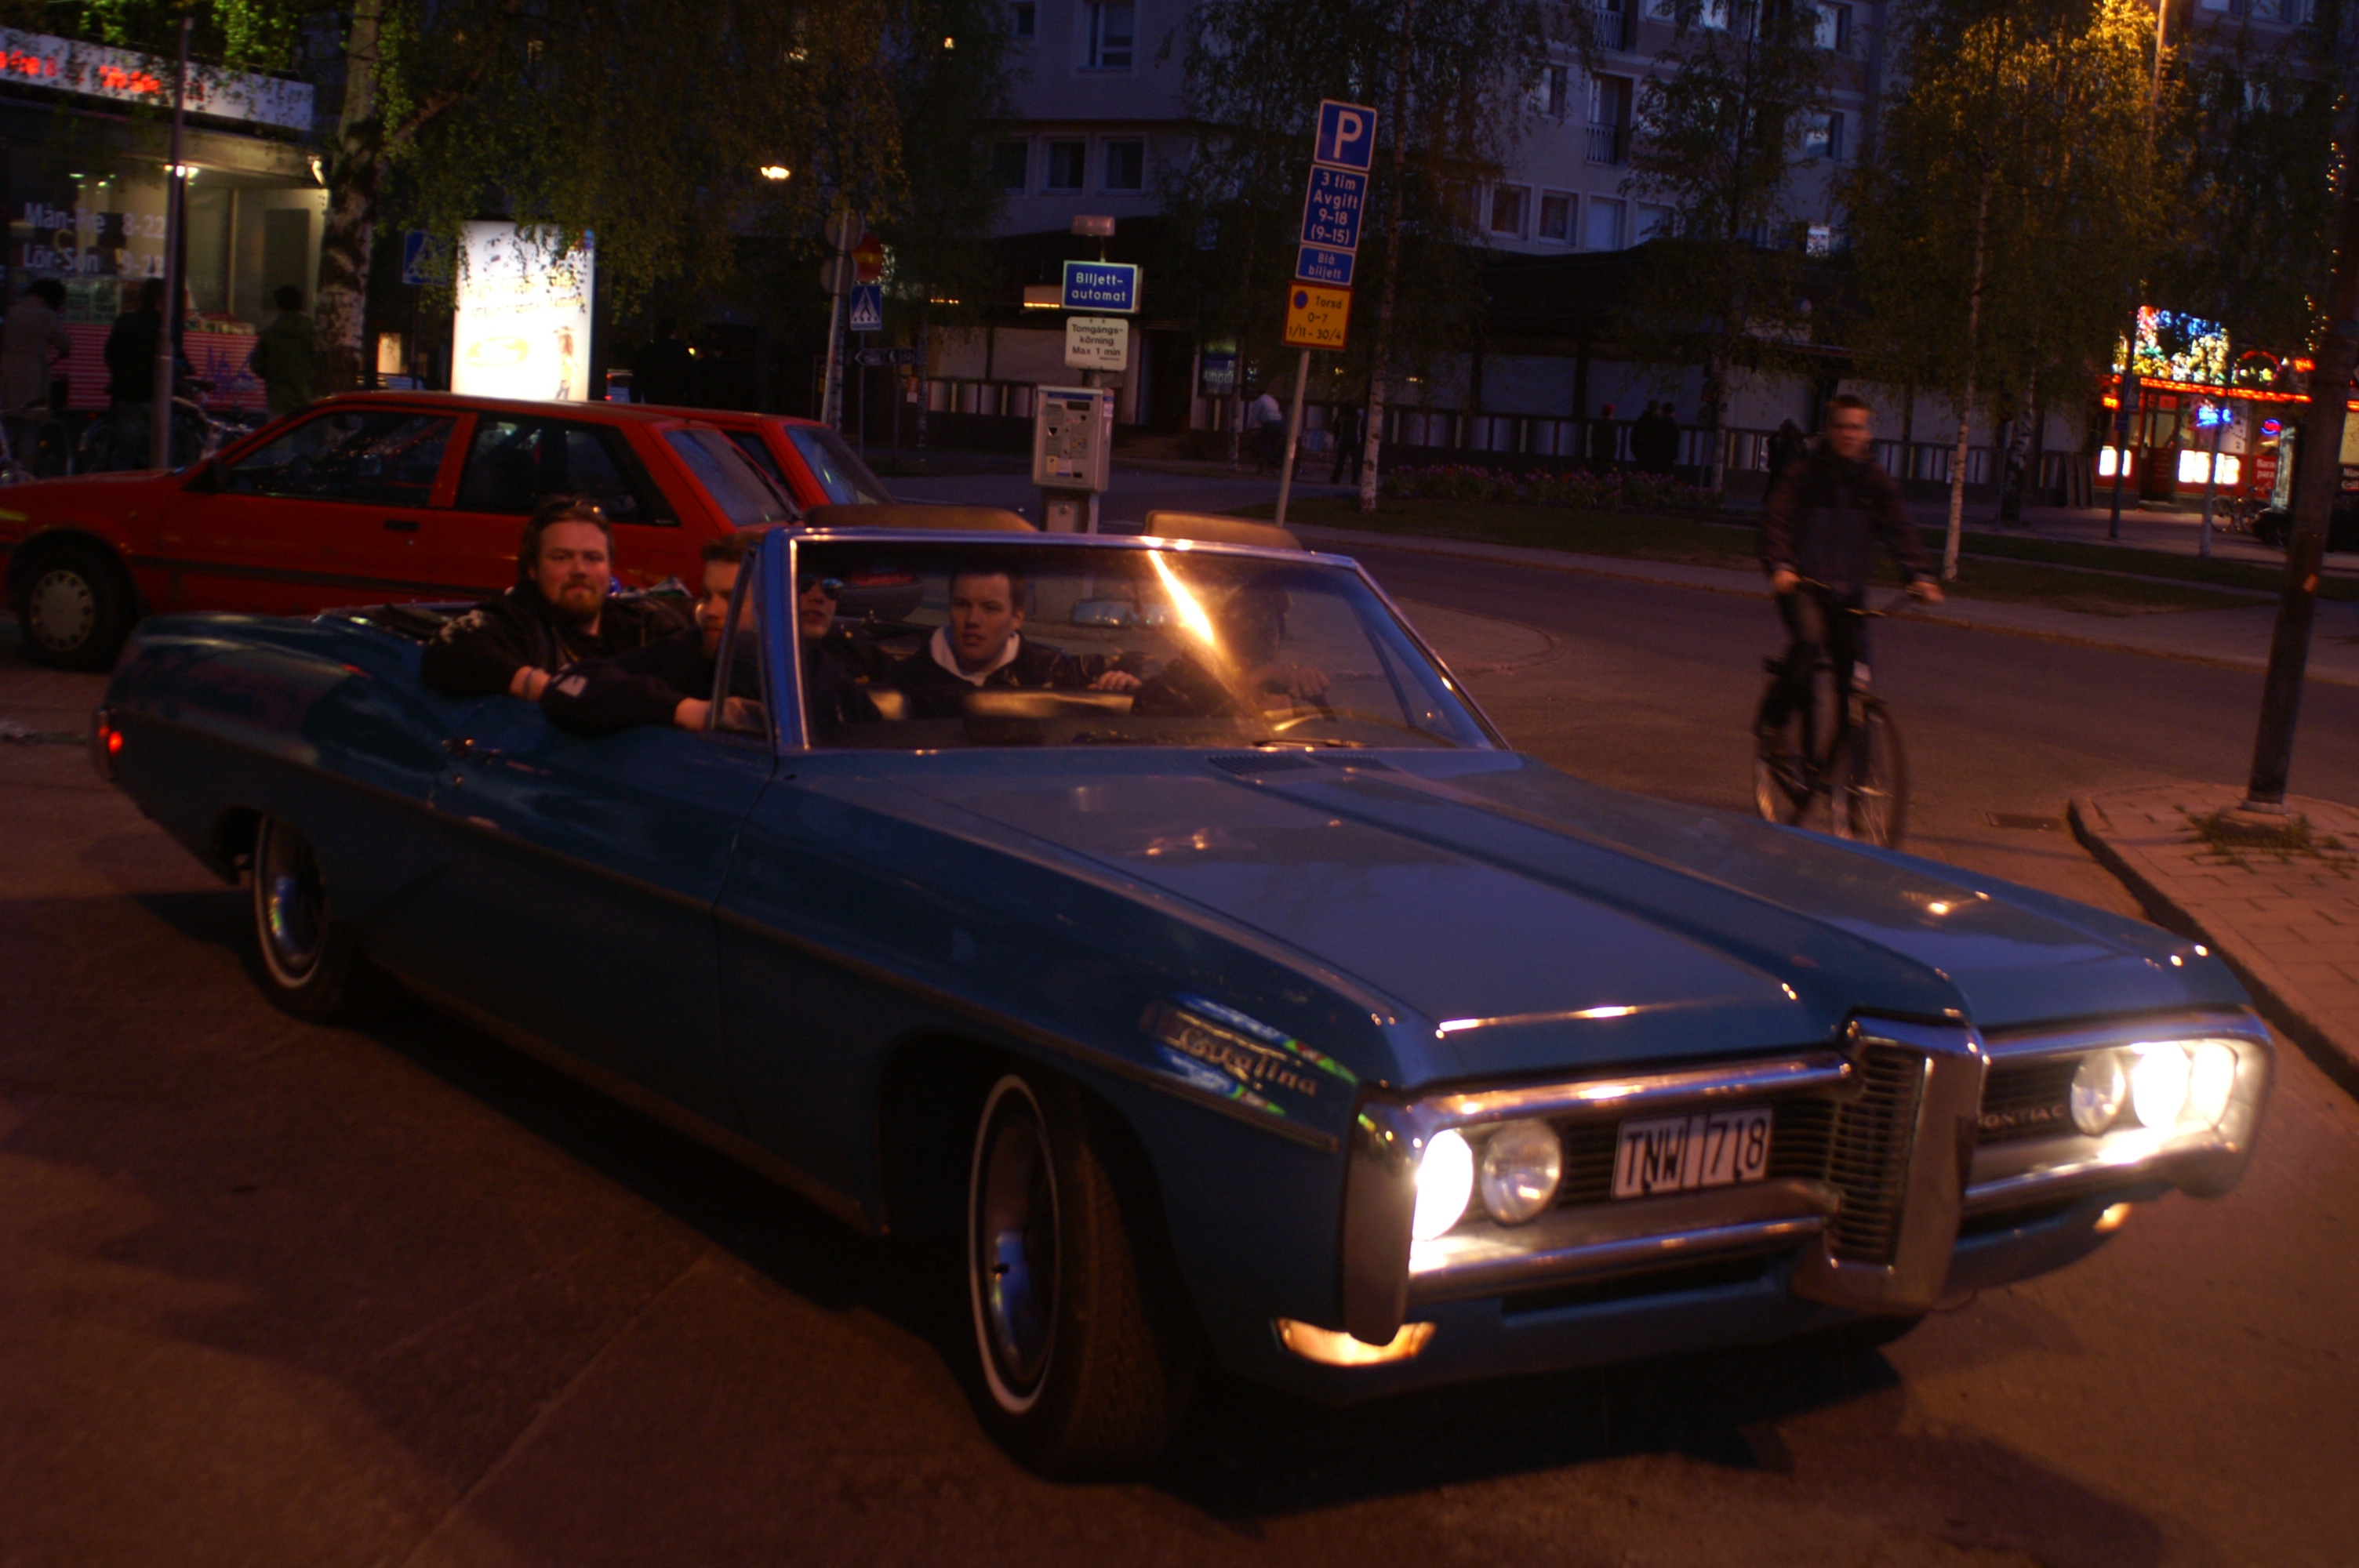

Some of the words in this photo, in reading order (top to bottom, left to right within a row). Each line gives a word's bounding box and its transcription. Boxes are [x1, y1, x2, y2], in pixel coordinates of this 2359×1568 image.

[1333, 110, 1364, 160] P
[1321, 172, 1330, 187] 3
[1335, 174, 1357, 191] tim
[1313, 188, 1358, 209] Avgift
[1318, 208, 1348, 226] 9-18
[1310, 223, 1351, 245] (9-15)
[1318, 252, 1336, 265] Blå
[1308, 264, 1342, 279] biljett
[1075, 272, 1123, 287] Biljett-
[1071, 289, 1126, 302] automat
[1316, 296, 1343, 310] Torsd
[1307, 311, 1328, 323] 0-7
[1071, 324, 1124, 336] Tomgångs-
[1080, 336, 1114, 347] körning
[1072, 346, 1092, 355] Max
[1179, 1028, 1318, 1097] Catalina
[1979, 1104, 2066, 1130] ONTIAC
[1626, 1126, 1686, 1186] TNW
[1708, 1116, 1767, 1176] 718
